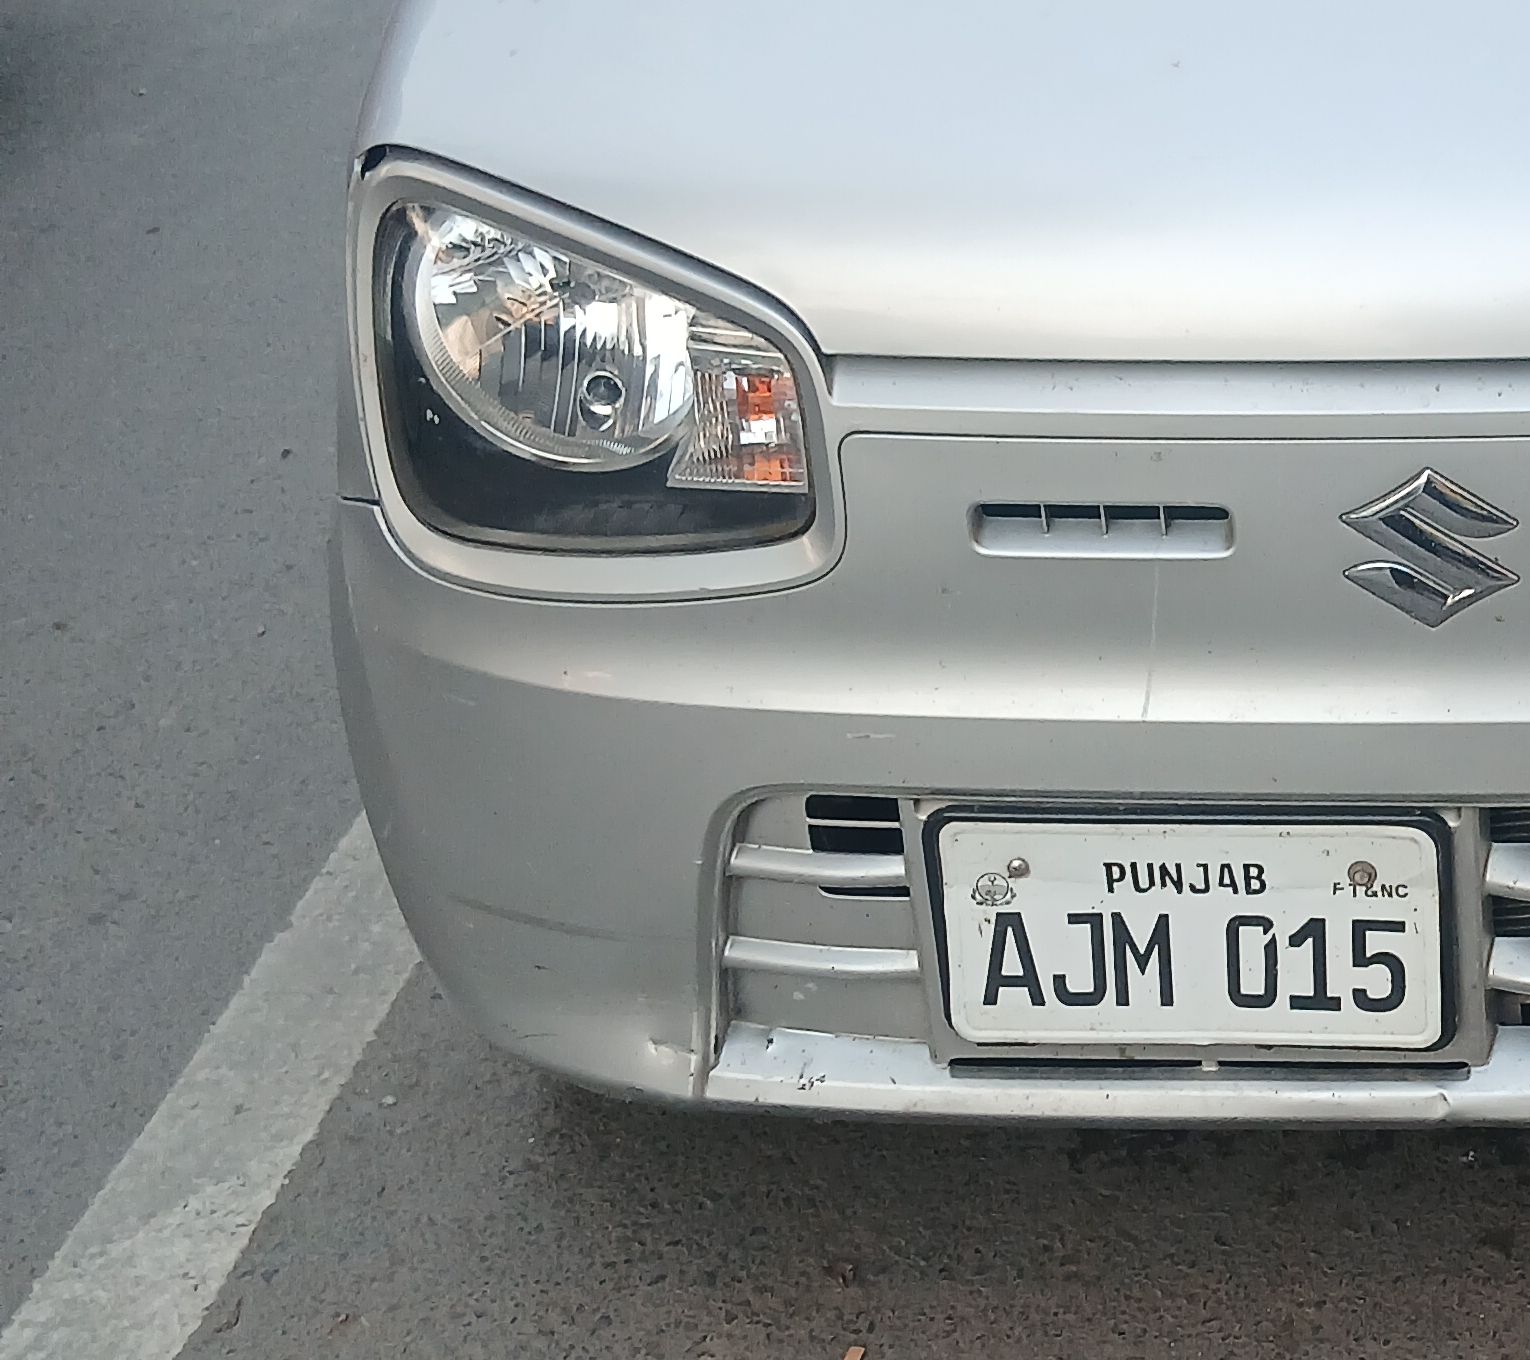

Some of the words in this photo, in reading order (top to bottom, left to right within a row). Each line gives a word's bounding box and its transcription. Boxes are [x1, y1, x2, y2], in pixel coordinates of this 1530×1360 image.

[1103, 861, 1267, 895] PUNJAB
[982, 912, 1174, 1007] AJM
[1225, 915, 1406, 1012] 015
